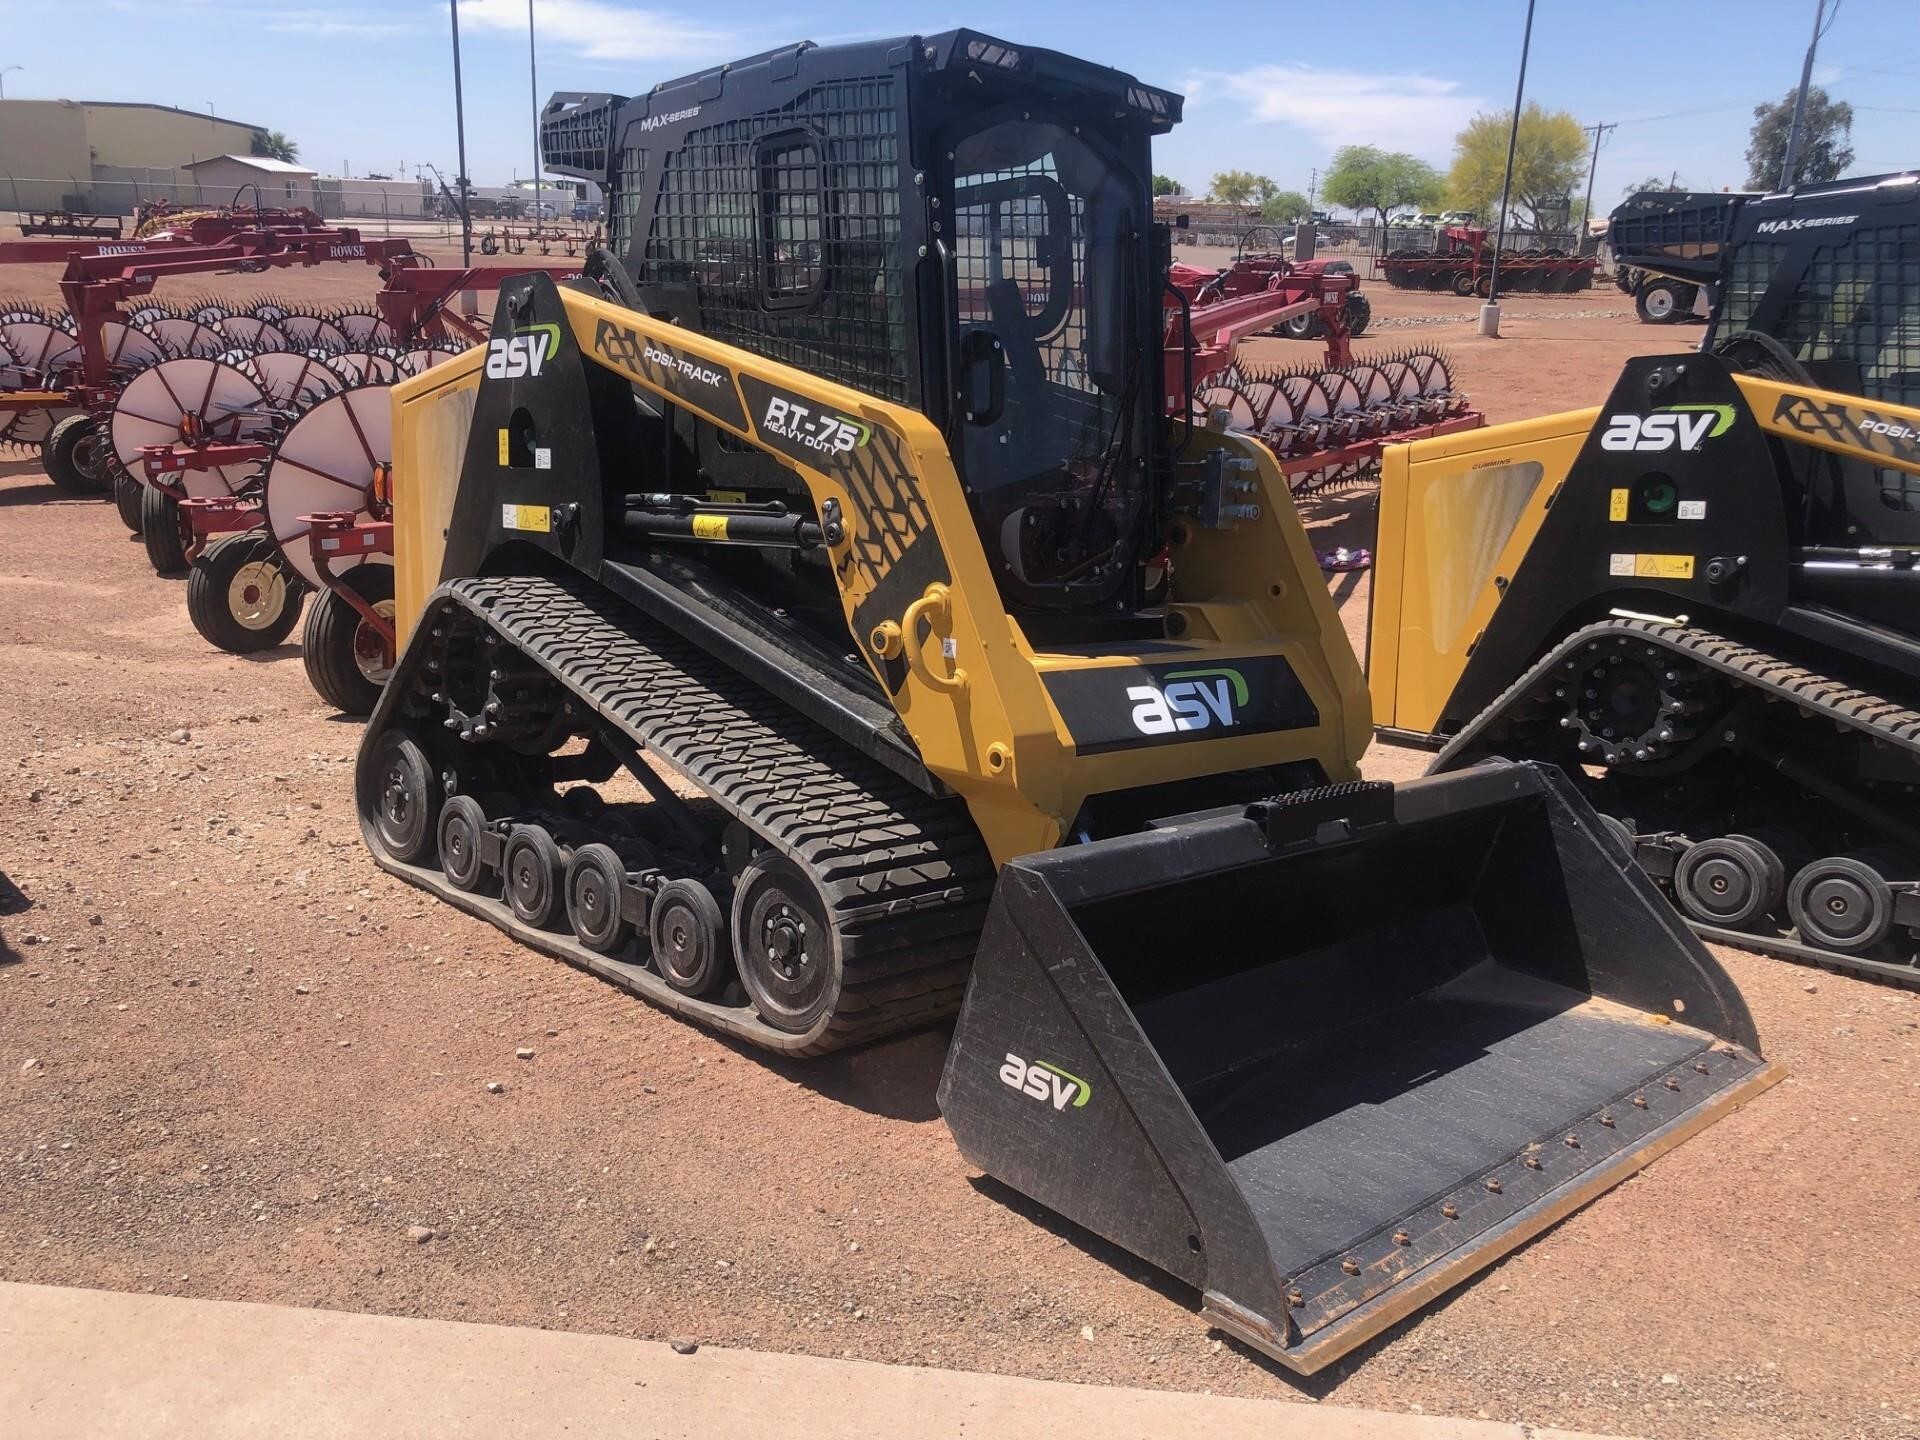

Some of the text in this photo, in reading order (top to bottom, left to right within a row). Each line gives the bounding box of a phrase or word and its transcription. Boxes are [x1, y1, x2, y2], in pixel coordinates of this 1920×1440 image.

[330, 245, 366, 257] ROWSE
[644, 347, 722, 388] POSI-TRACK
[763, 421, 840, 456] HEAVY DUTY
[764, 396, 859, 452] RT-75
[1858, 419, 1920, 443] POSI-
